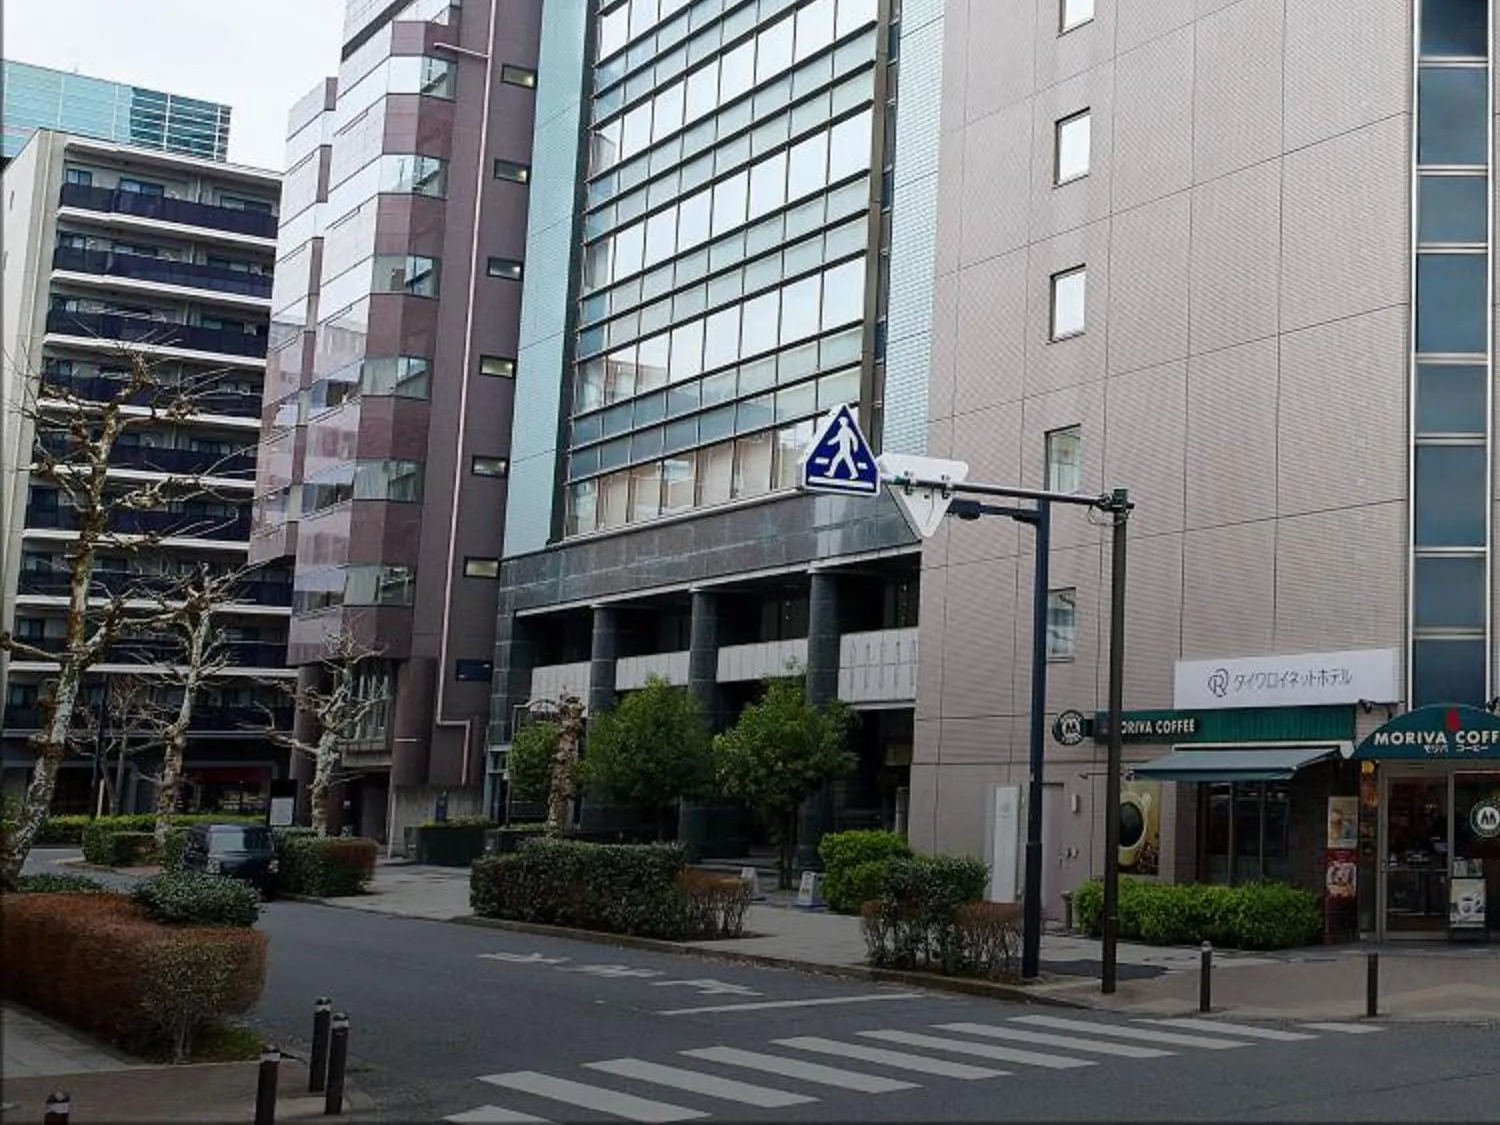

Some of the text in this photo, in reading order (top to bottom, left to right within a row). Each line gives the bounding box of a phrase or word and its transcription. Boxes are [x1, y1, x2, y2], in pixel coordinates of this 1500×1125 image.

[1121, 718, 1195, 734] ORIVA COFFEE
[1374, 731, 1447, 746] MORIVA
